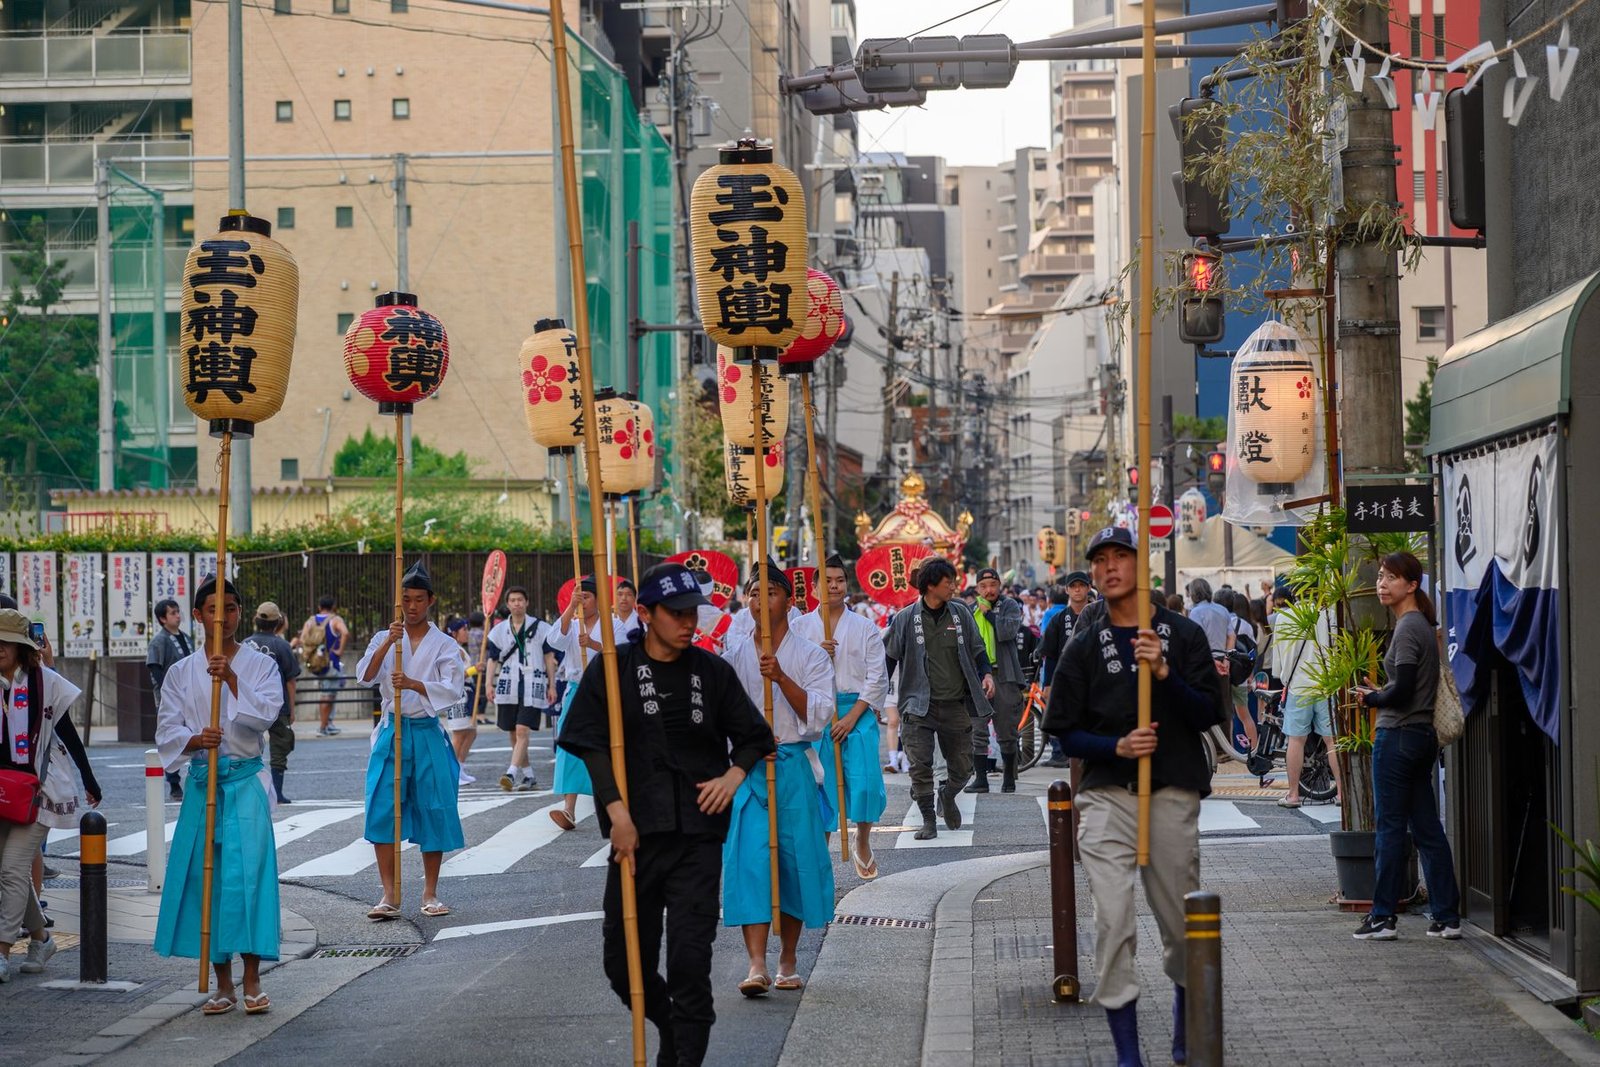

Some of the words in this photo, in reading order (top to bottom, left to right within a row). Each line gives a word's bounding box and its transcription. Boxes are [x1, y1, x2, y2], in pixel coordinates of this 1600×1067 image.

[708, 173, 793, 335] 玉神輿
[185, 240, 265, 404] 玉神輿
[381, 309, 444, 393] 神輿
[598, 404, 613, 444] 中央市場
[1354, 496, 1425, 521] 手打蕎麦
